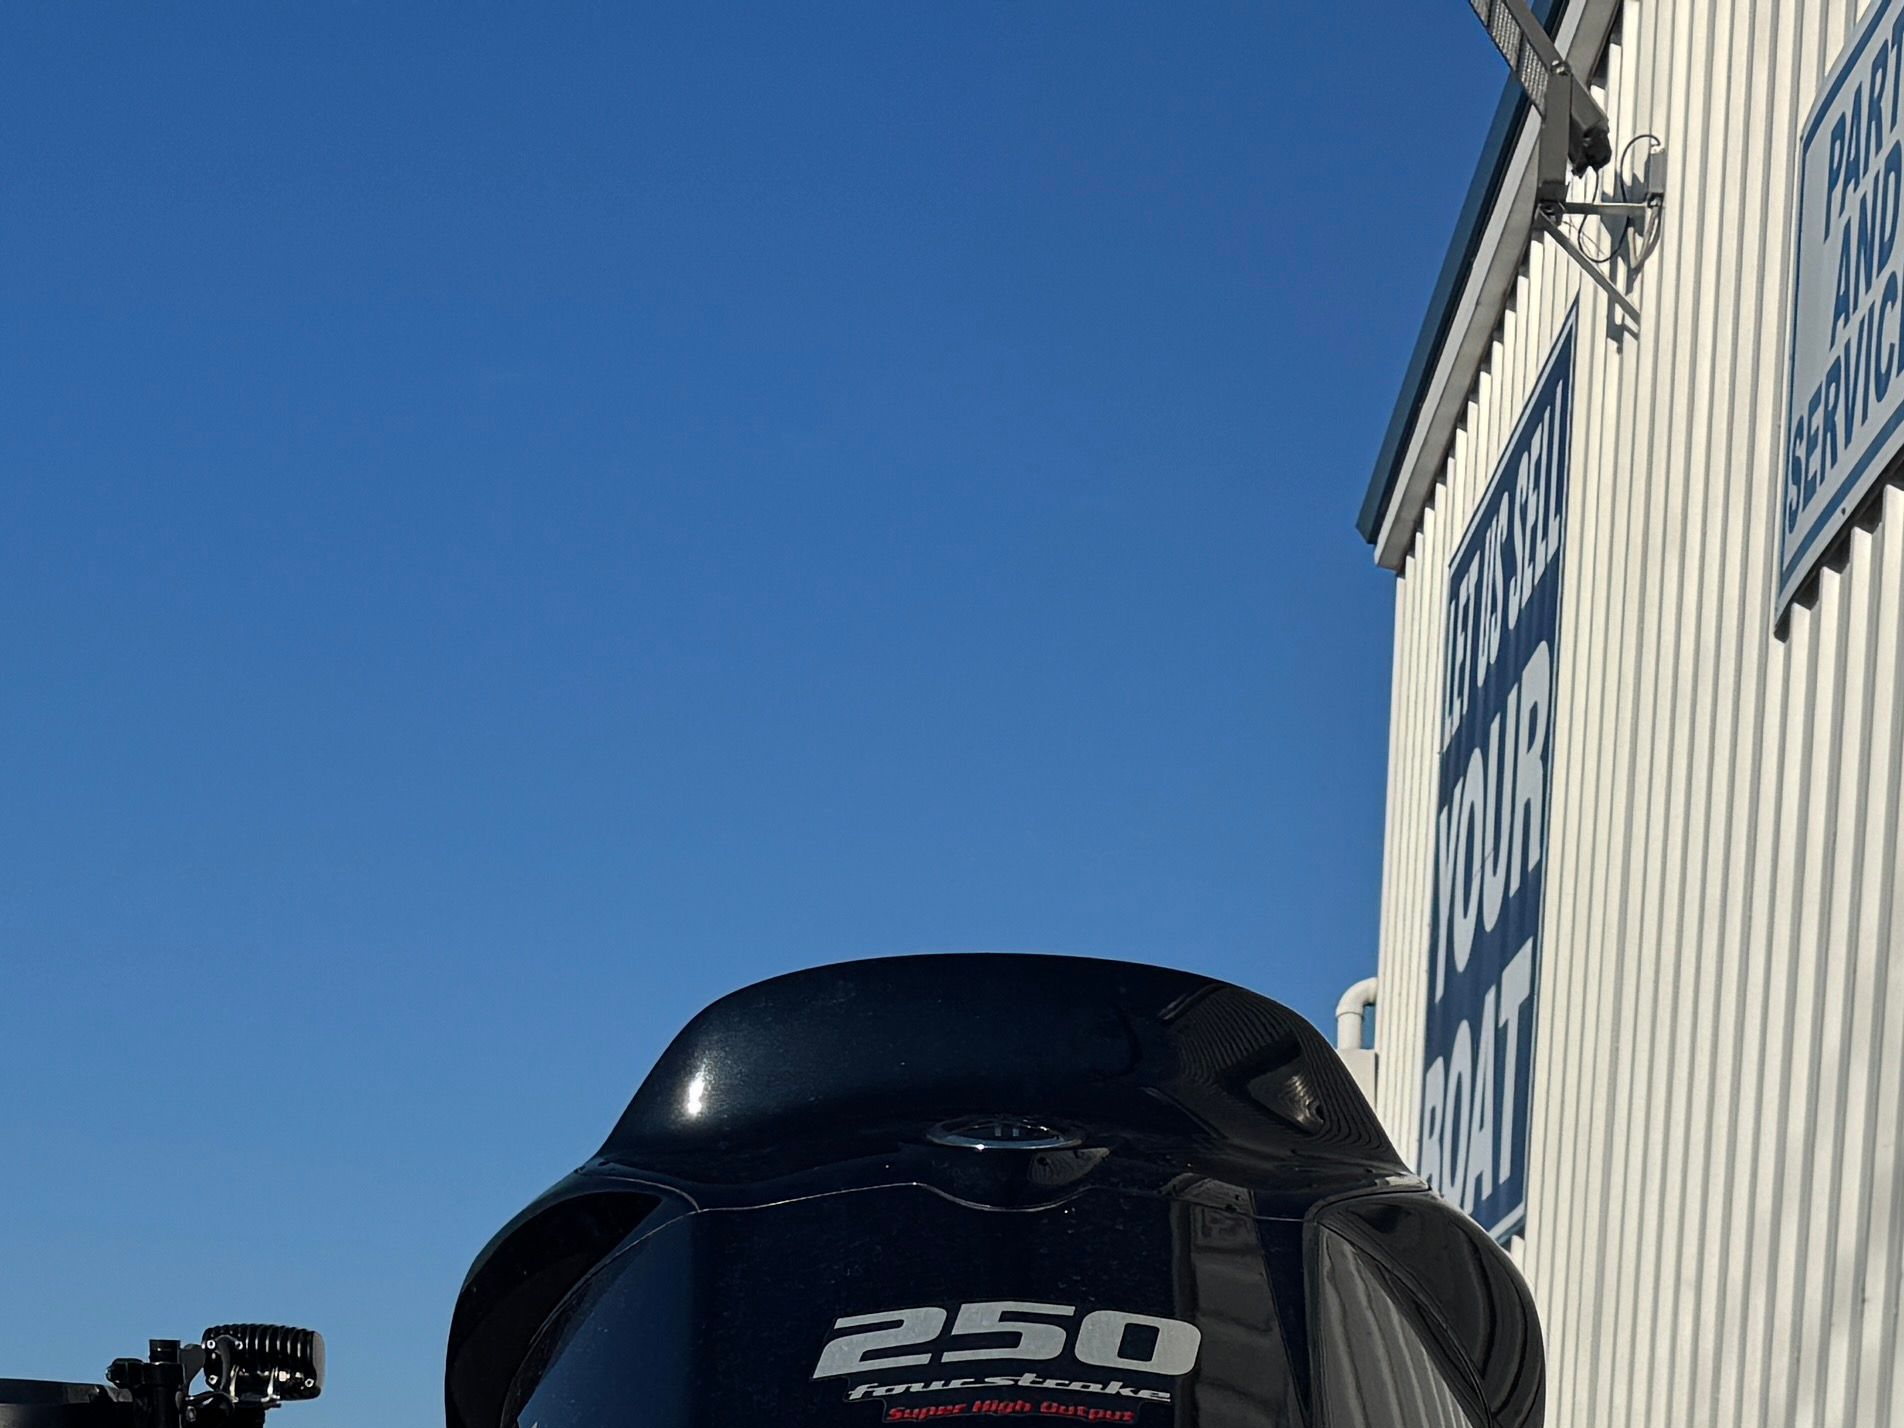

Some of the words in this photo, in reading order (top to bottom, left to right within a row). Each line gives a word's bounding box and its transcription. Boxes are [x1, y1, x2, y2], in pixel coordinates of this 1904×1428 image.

[1829, 138, 1903, 351] AND
[1442, 549, 1481, 753] LET
[1477, 491, 1510, 687] US
[1508, 379, 1563, 631] SELL
[1434, 640, 1550, 1003] YOUR
[1421, 937, 1533, 1214] BOAT
[812, 1300, 1202, 1379] 250
[886, 1402, 968, 1422] Super
[972, 1400, 1032, 1416] High
[1040, 1401, 1135, 1424] Output
